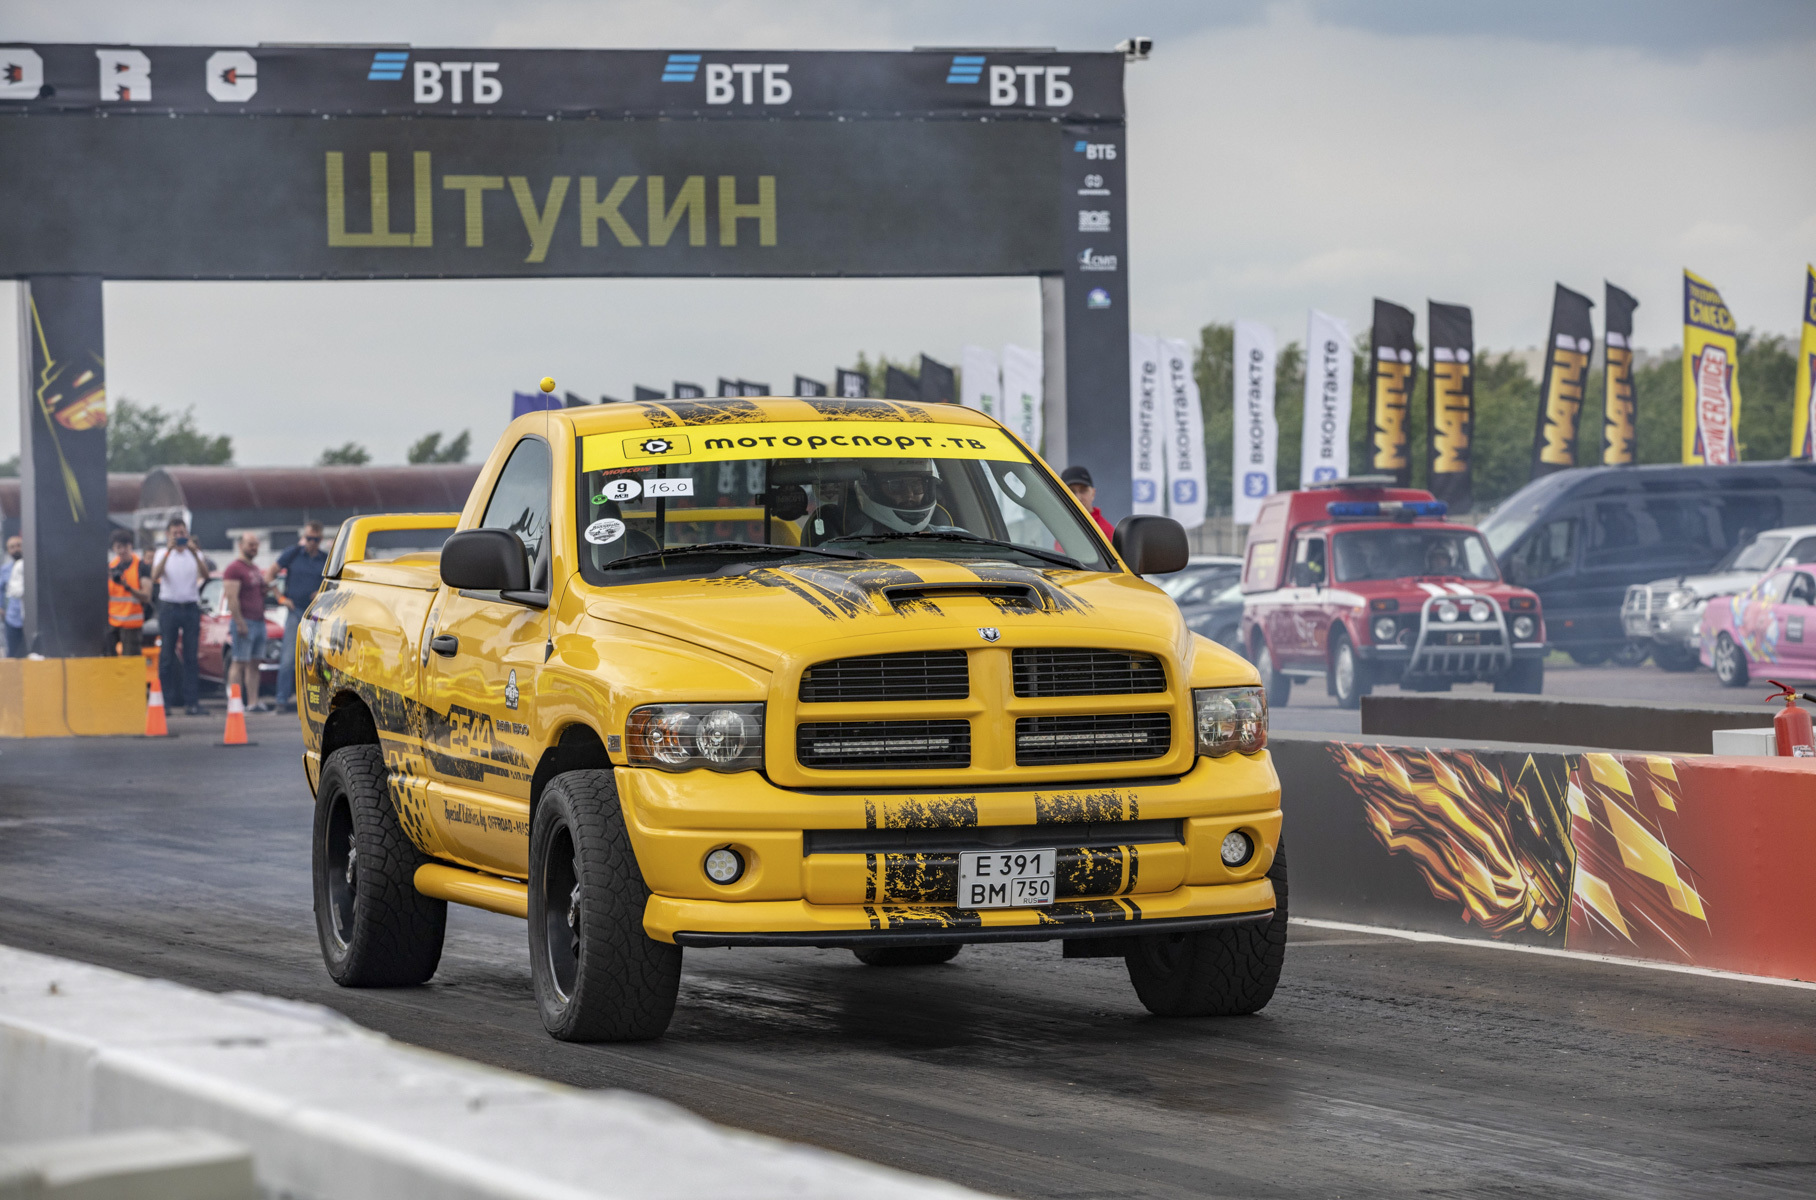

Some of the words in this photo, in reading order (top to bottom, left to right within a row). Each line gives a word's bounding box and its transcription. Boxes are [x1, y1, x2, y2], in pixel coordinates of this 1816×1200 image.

[413, 61, 503, 104] ВТБ
[705, 63, 793, 105] ВТБ
[988, 65, 1074, 107] ВТБ
[1086, 143, 1117, 160] ВТБ
[325, 150, 778, 263] Штукин
[1373, 345, 1414, 470] МАТЧ!
[1433, 346, 1471, 474] МАТЧ!
[1540, 333, 1592, 466] МАТЧ!
[602, 466, 652, 477] MOSCOW
[616, 482, 628, 493] 9
[649, 482, 688, 494] 16.0
[449, 712, 493, 760] 2544
[976, 856, 991, 877] Е
[999, 853, 1041, 876] 391
[970, 883, 1006, 905] ВМ
[1016, 879, 1050, 898] 750
